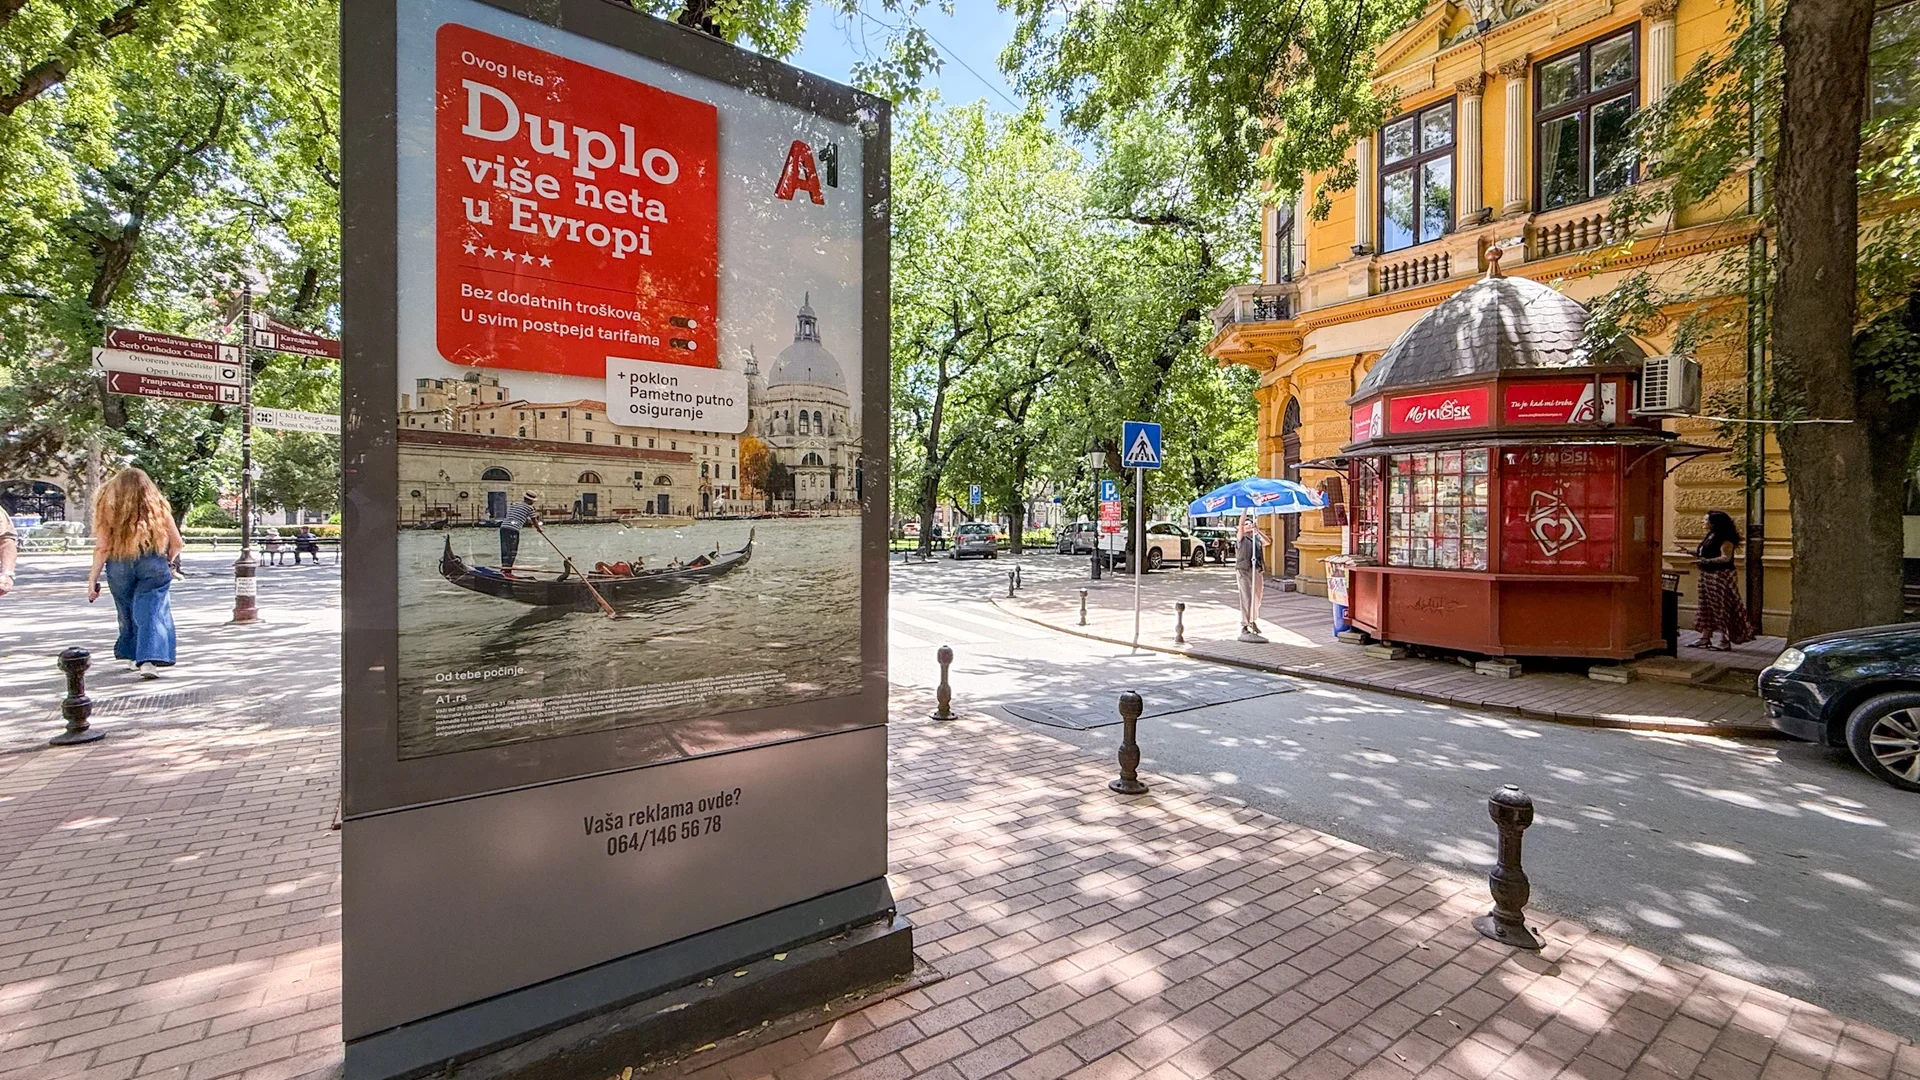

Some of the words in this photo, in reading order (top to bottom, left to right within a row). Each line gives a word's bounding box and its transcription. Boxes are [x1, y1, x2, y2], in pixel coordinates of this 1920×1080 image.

[461, 50, 507, 78] Ovog
[512, 64, 544, 87] leta
[461, 78, 680, 185] Duplo
[774, 139, 839, 206] A1
[461, 155, 561, 199] više
[575, 181, 668, 224] neta
[462, 196, 493, 226] u
[509, 196, 652, 260] Evropi
[461, 283, 493, 301] Bez
[497, 288, 572, 312] dodatnih
[576, 301, 641, 322] troškova
[461, 309, 473, 322] U
[478, 313, 518, 328] svim
[522, 317, 593, 339] postpejd
[597, 326, 660, 347] tarifama
[119, 341, 140, 350] Serb
[141, 343, 182, 355] Orthodox
[183, 349, 213, 360] Church
[138, 333, 189, 347] Pravoslavna
[190, 342, 213, 350] crkva
[129, 354, 170, 365] Otvoreno
[140, 376, 191, 388] Franjevačka
[191, 383, 214, 391] crkva
[146, 366, 169, 375] Open
[171, 369, 213, 380] University
[629, 371, 678, 387] poklon
[139, 386, 184, 398] Franciscan
[185, 391, 214, 400] Church
[630, 386, 692, 403] Pametno
[696, 393, 734, 408] putno
[629, 402, 703, 420] osiguranje
[1405, 406, 1427, 423] Moj
[1427, 400, 1471, 420] KIOSK
[436, 671, 453, 682] Od
[455, 669, 481, 681] tebe
[484, 666, 527, 680] počinje.
[436, 694, 467, 704] A1.rs
[583, 812, 624, 836] Vaša
[629, 801, 694, 827] reklama
[698, 787, 742, 813] ovde?
[607, 824, 677, 856] 064/146
[681, 819, 700, 840] 56
[704, 814, 722, 835] 78
